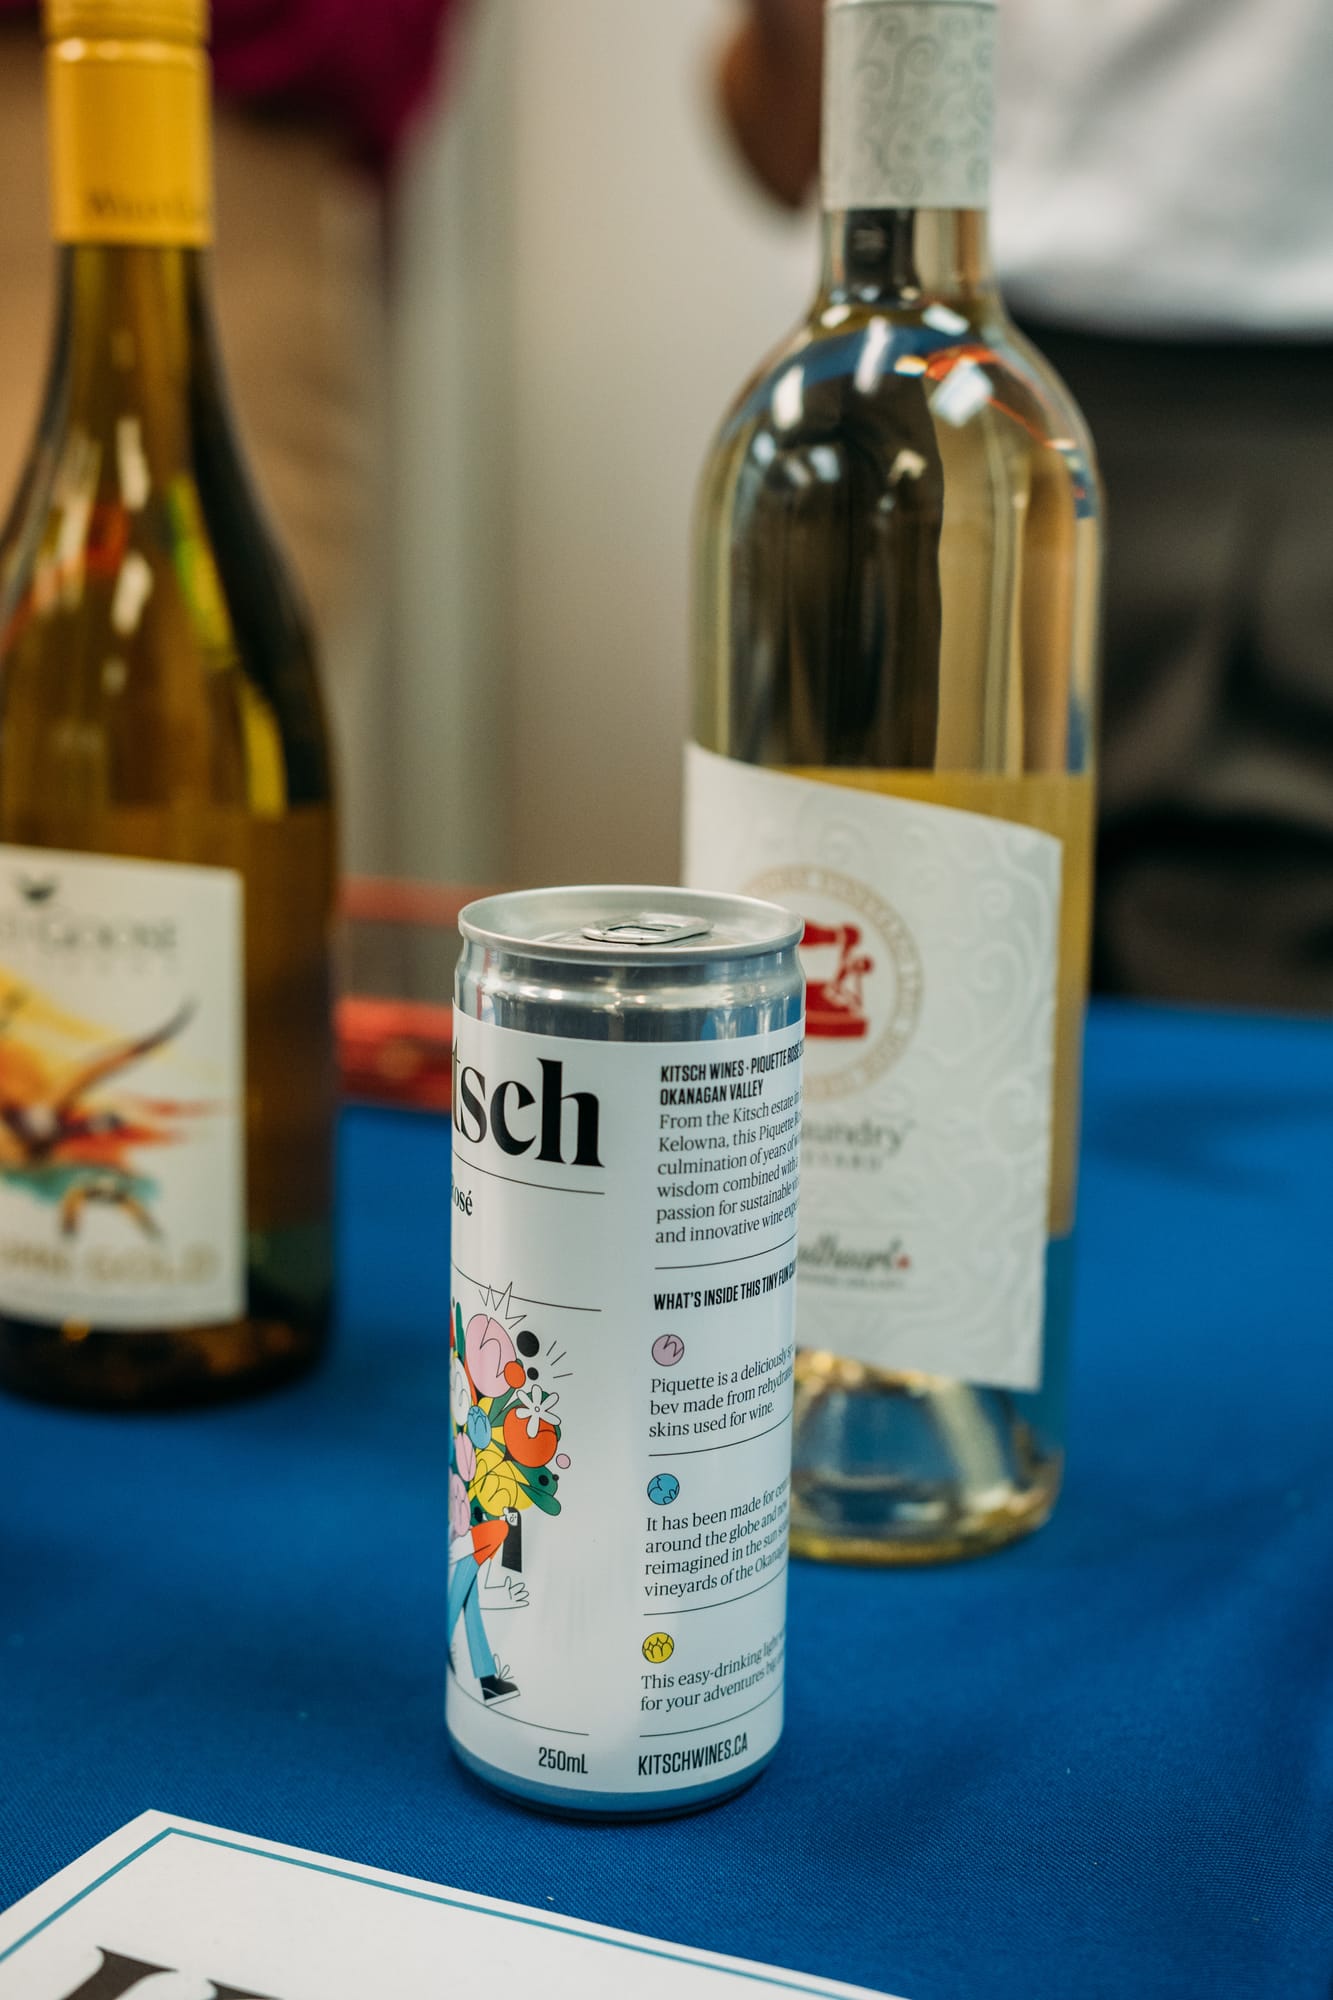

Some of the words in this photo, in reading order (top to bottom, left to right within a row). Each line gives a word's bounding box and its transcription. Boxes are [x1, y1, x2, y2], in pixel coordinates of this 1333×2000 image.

[661, 1064, 706, 1082] KITSCH
[710, 1060, 744, 1080] WINES
[751, 1049, 787, 1074] PIQUETTE
[452, 1037, 605, 1168] tsch
[660, 1085, 727, 1105] OKANAGAN
[730, 1079, 764, 1100] VALLEY
[659, 1114, 702, 1129] From
[707, 1110, 729, 1126] the
[733, 1102, 769, 1123] Kitsch
[771, 1096, 793, 1115] estate
[659, 1136, 729, 1152] Kelowna,
[733, 1129, 756, 1146] this
[759, 1117, 794, 1141] Piquette
[657, 1154, 747, 1175] culmination
[750, 1148, 763, 1165] of
[763, 1143, 786, 1166] years
[787, 1138, 794, 1152] of
[657, 1180, 719, 1198] wisdom
[722, 1164, 779, 1193] combined
[781, 1156, 795, 1176] with
[656, 1204, 715, 1225] passion
[719, 1199, 738, 1216] for
[740, 1181, 791, 1213] sustainable
[655, 1227, 686, 1244] and
[690, 1218, 760, 1242] innovative
[762, 1209, 784, 1228] wine
[654, 1291, 701, 1311] WHAT'S
[704, 1285, 739, 1307] INSIDE
[740, 1279, 761, 1300] THIS
[762, 1271, 779, 1294] TINY
[778, 1265, 789, 1286] FUN
[651, 1376, 714, 1396] Piquette
[718, 1371, 728, 1386] is
[730, 1371, 738, 1384] a
[741, 1348, 787, 1381] deliciously
[648, 1422, 690, 1438] skins
[693, 1414, 727, 1434] used
[729, 1410, 747, 1427] for
[749, 1401, 774, 1421] wine.
[650, 1399, 679, 1416] bev
[683, 1394, 724, 1414] made
[727, 1387, 755, 1407] from
[646, 1517, 657, 1532] It
[662, 1515, 689, 1531] has
[692, 1511, 727, 1528] been
[730, 1497, 761, 1520] made
[763, 1491, 774, 1507] for
[645, 1533, 701, 1554] around
[705, 1530, 727, 1547] the
[728, 1520, 760, 1544] globe
[760, 1511, 777, 1529] and
[645, 1549, 729, 1575] reimagined
[731, 1547, 743, 1562] in
[745, 1540, 761, 1557] the
[645, 1575, 717, 1598] vineyards
[720, 1568, 734, 1586] of
[735, 1565, 753, 1583] the
[641, 1674, 675, 1690] This
[678, 1648, 762, 1687] easy-drinking
[640, 1696, 665, 1712] for
[665, 1693, 701, 1713] your
[703, 1668, 766, 1704] adventures
[538, 1746, 589, 1775] 250mL
[638, 1731, 748, 1777] KITSCHWINES.CA
